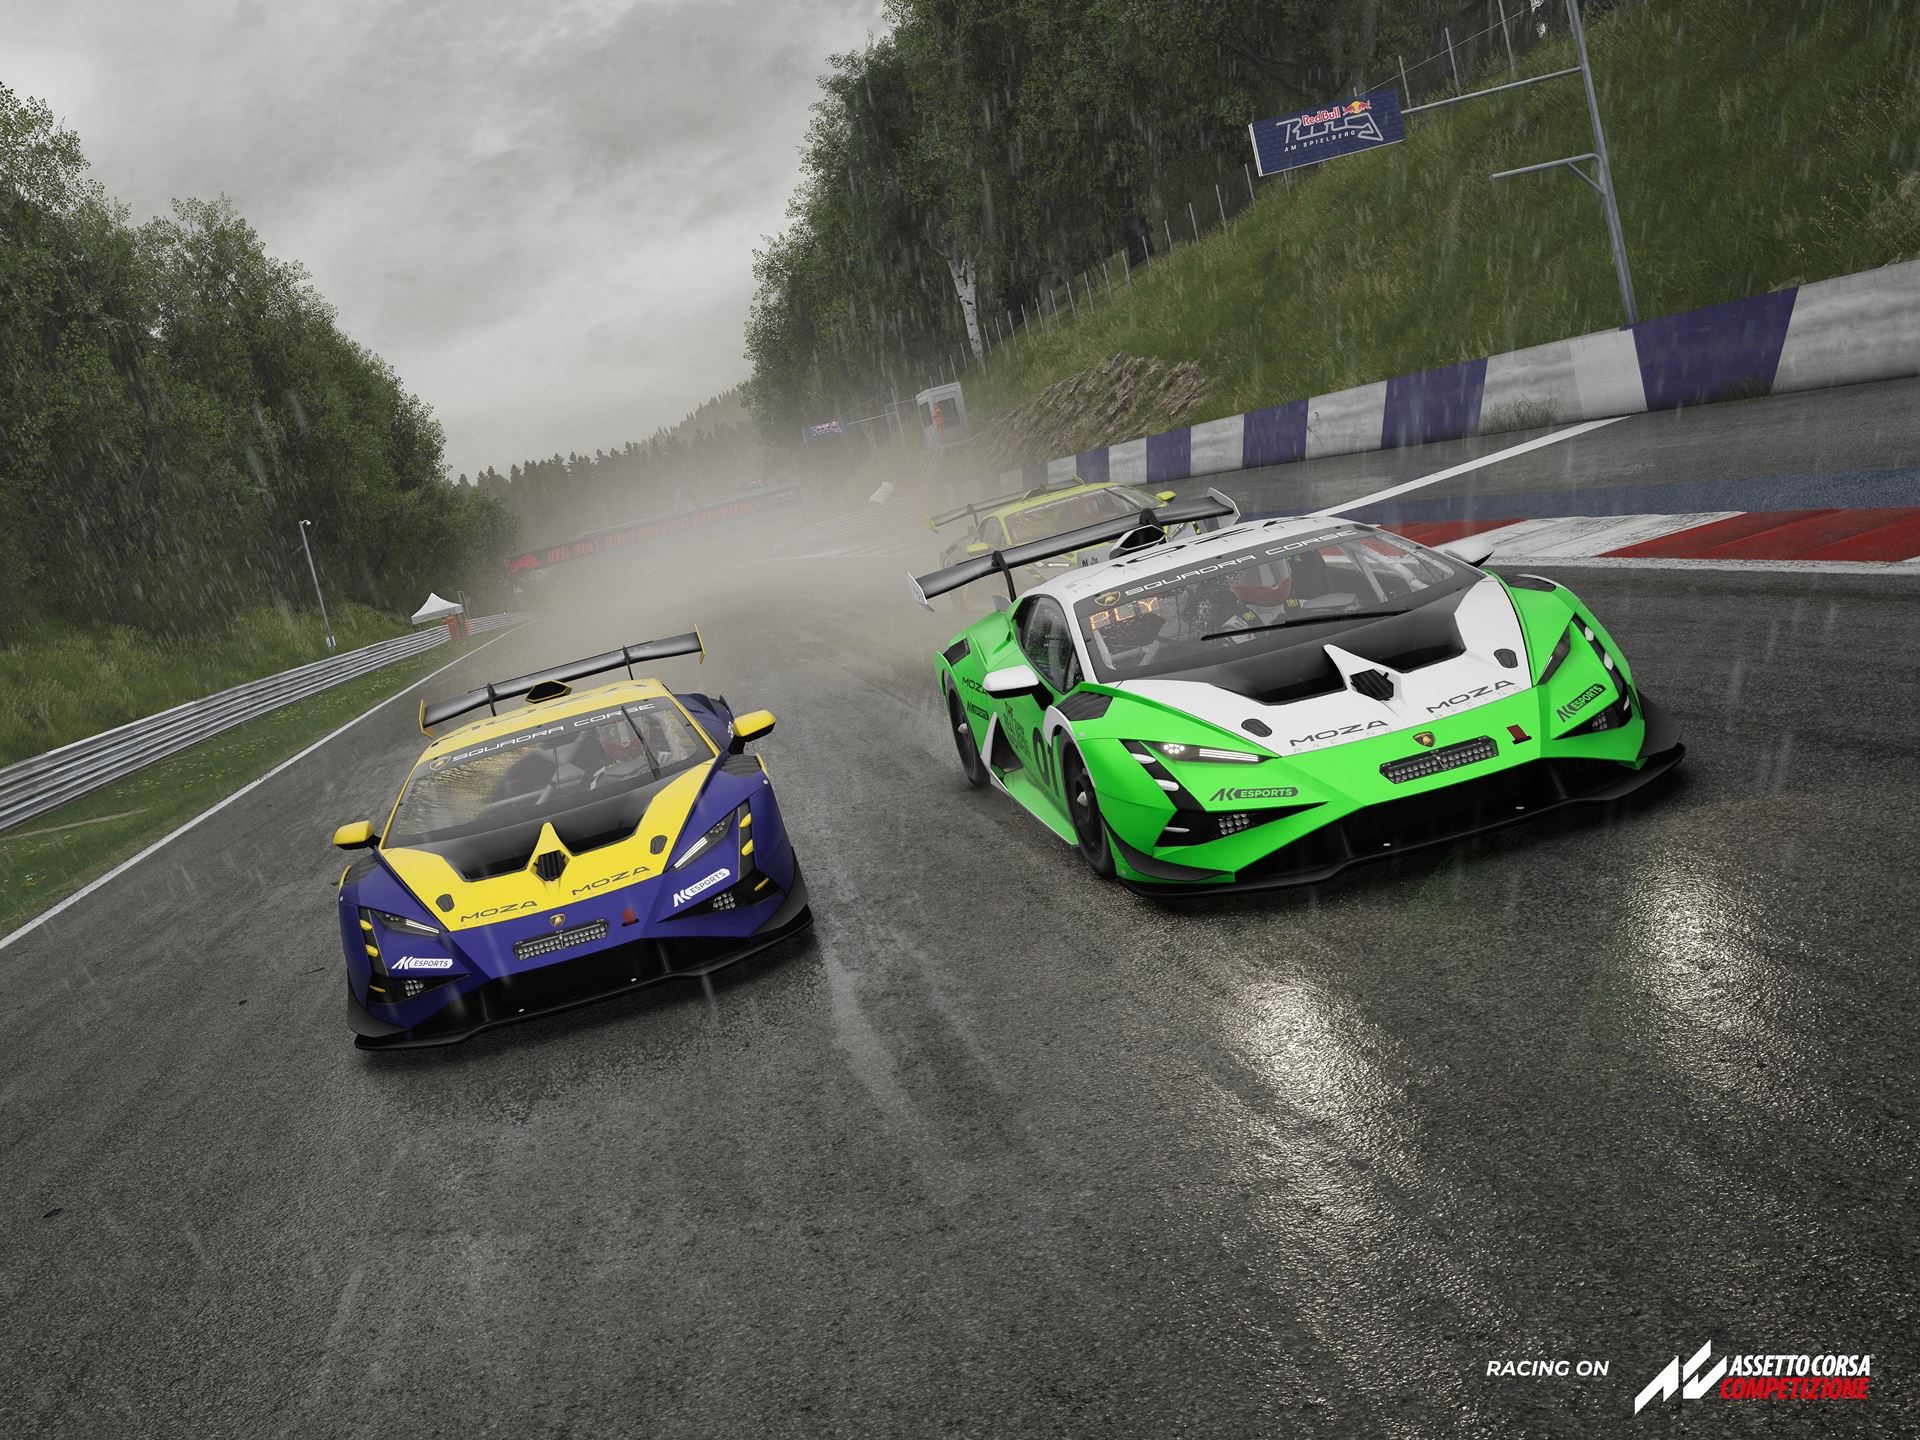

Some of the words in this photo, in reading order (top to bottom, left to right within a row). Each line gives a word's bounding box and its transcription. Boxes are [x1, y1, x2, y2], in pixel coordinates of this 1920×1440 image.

[1302, 111, 1322, 126] Red
[1322, 106, 1341, 121] Bull
[1284, 144, 1297, 152] AM
[1303, 130, 1356, 148] SPIELBERG
[547, 546, 570, 562] RED
[1125, 554, 1256, 596] SQUADRA
[1265, 528, 1357, 556] CORSE
[1426, 680, 1516, 713] MOZA
[1570, 685, 1604, 709] ESPORTS
[452, 725, 564, 762] SQUADRA
[574, 703, 656, 727] CORSE
[1289, 720, 1390, 747] MOZA
[1240, 788, 1293, 798] ESPORTS
[572, 866, 651, 896] MOZA
[689, 871, 726, 894] ESPORTS
[460, 900, 538, 922] MOZA
[414, 959, 448, 967] ESPORTS
